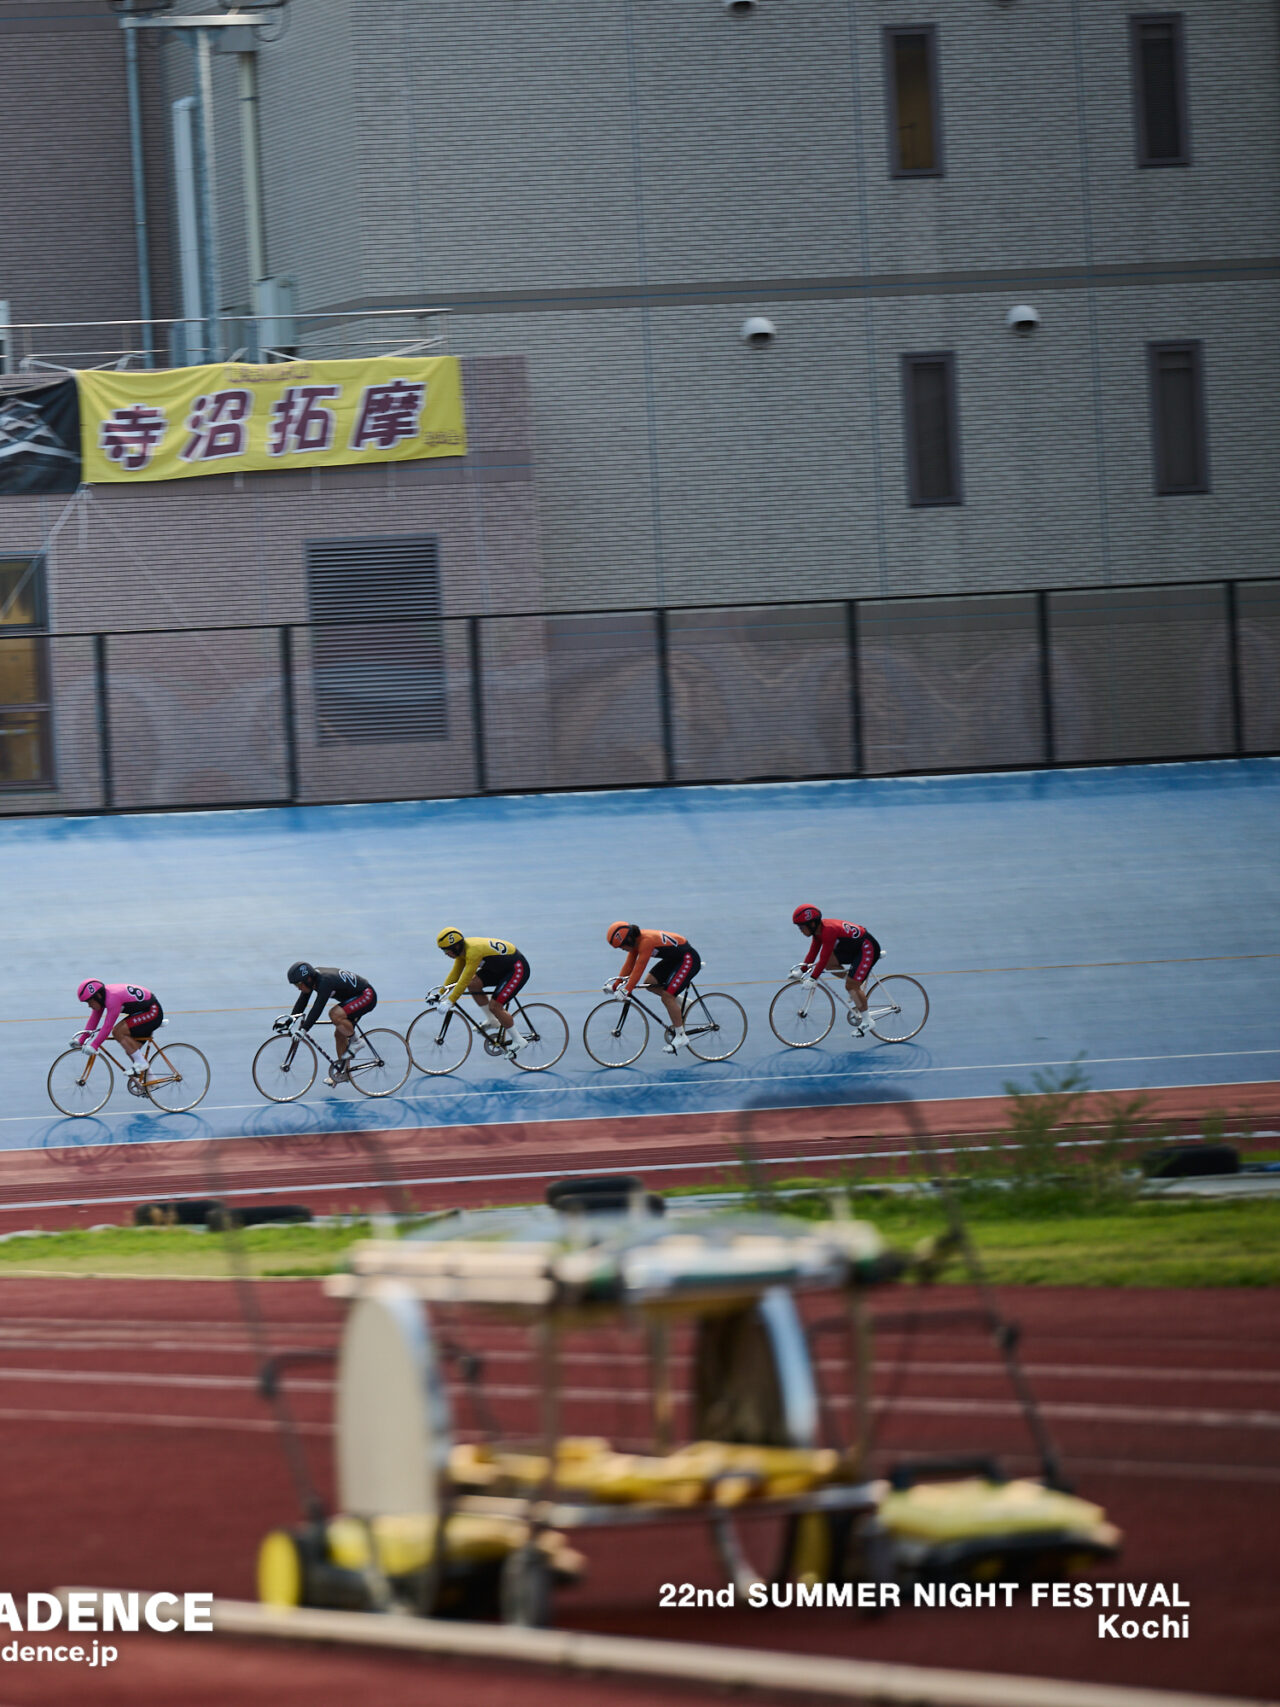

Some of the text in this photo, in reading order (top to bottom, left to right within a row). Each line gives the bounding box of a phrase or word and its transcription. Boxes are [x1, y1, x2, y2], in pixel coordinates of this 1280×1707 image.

[98, 378, 427, 471] 寺沼拓摩
[804, 909, 813, 921] 3
[842, 921, 861, 939] 3
[660, 932, 678, 947] 7
[488, 940, 508, 955] 5
[299, 964, 309, 977] 2
[338, 969, 358, 988] 2
[87, 984, 96, 994] 8
[126, 985, 145, 1002] 8
